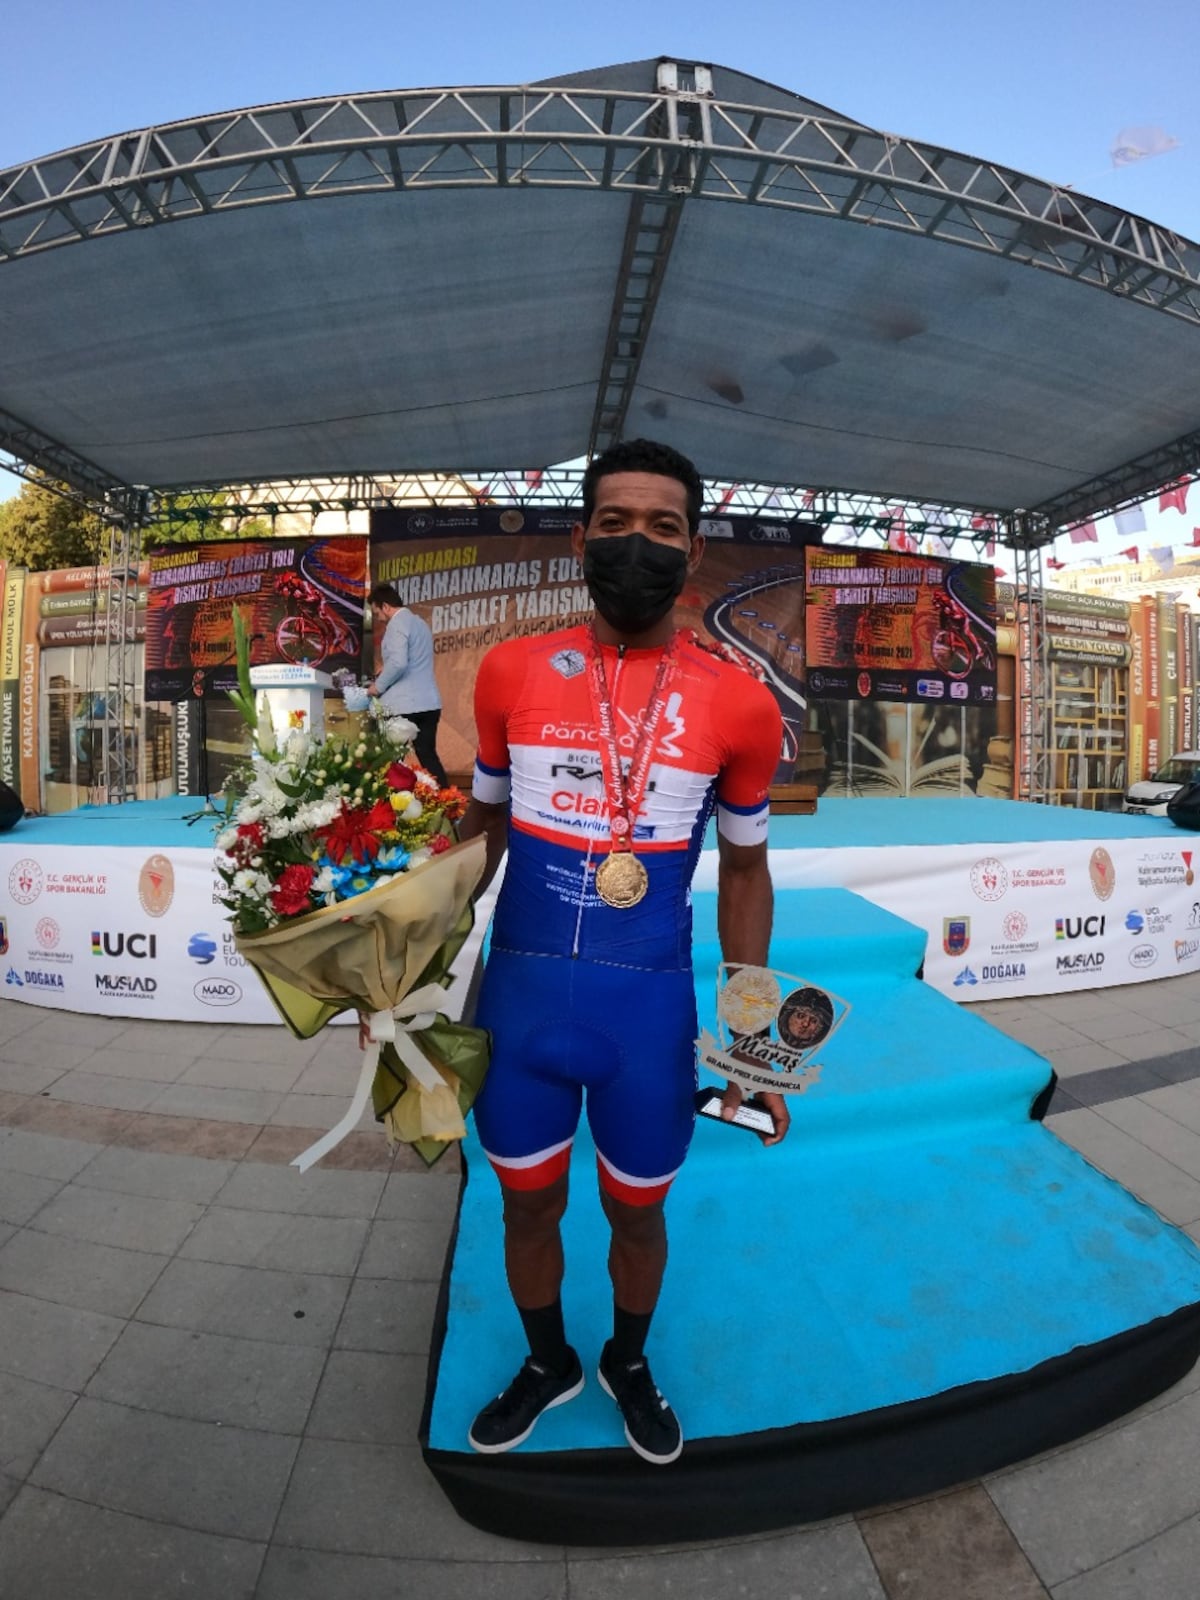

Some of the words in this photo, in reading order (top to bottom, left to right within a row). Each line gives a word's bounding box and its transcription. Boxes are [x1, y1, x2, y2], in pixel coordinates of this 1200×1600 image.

[378, 546, 478, 581] ULUSLARARASI
[390, 560, 542, 606] HRAMANMARAŞ
[432, 594, 510, 635] BİSİKLET
[516, 586, 595, 622] YARIŞM
[1134, 632, 1143, 695] SAFAHAT
[1166, 650, 1177, 679] ÇİLE
[551, 791, 609, 817] Clar
[537, 811, 610, 832] CopaAirlin
[46, 885, 65, 893] SPOR
[97, 875, 107, 883] VE
[1012, 879, 1031, 888] SPOR
[1065, 915, 1106, 939] UCI
[104, 932, 157, 959] UCI
[224, 957, 250, 967] TOU
[982, 961, 1026, 980] DOĞAKA
[24, 968, 64, 987] DOĞAKA
[202, 985, 236, 996] MADO
[706, 1055, 732, 1072] GRAND
